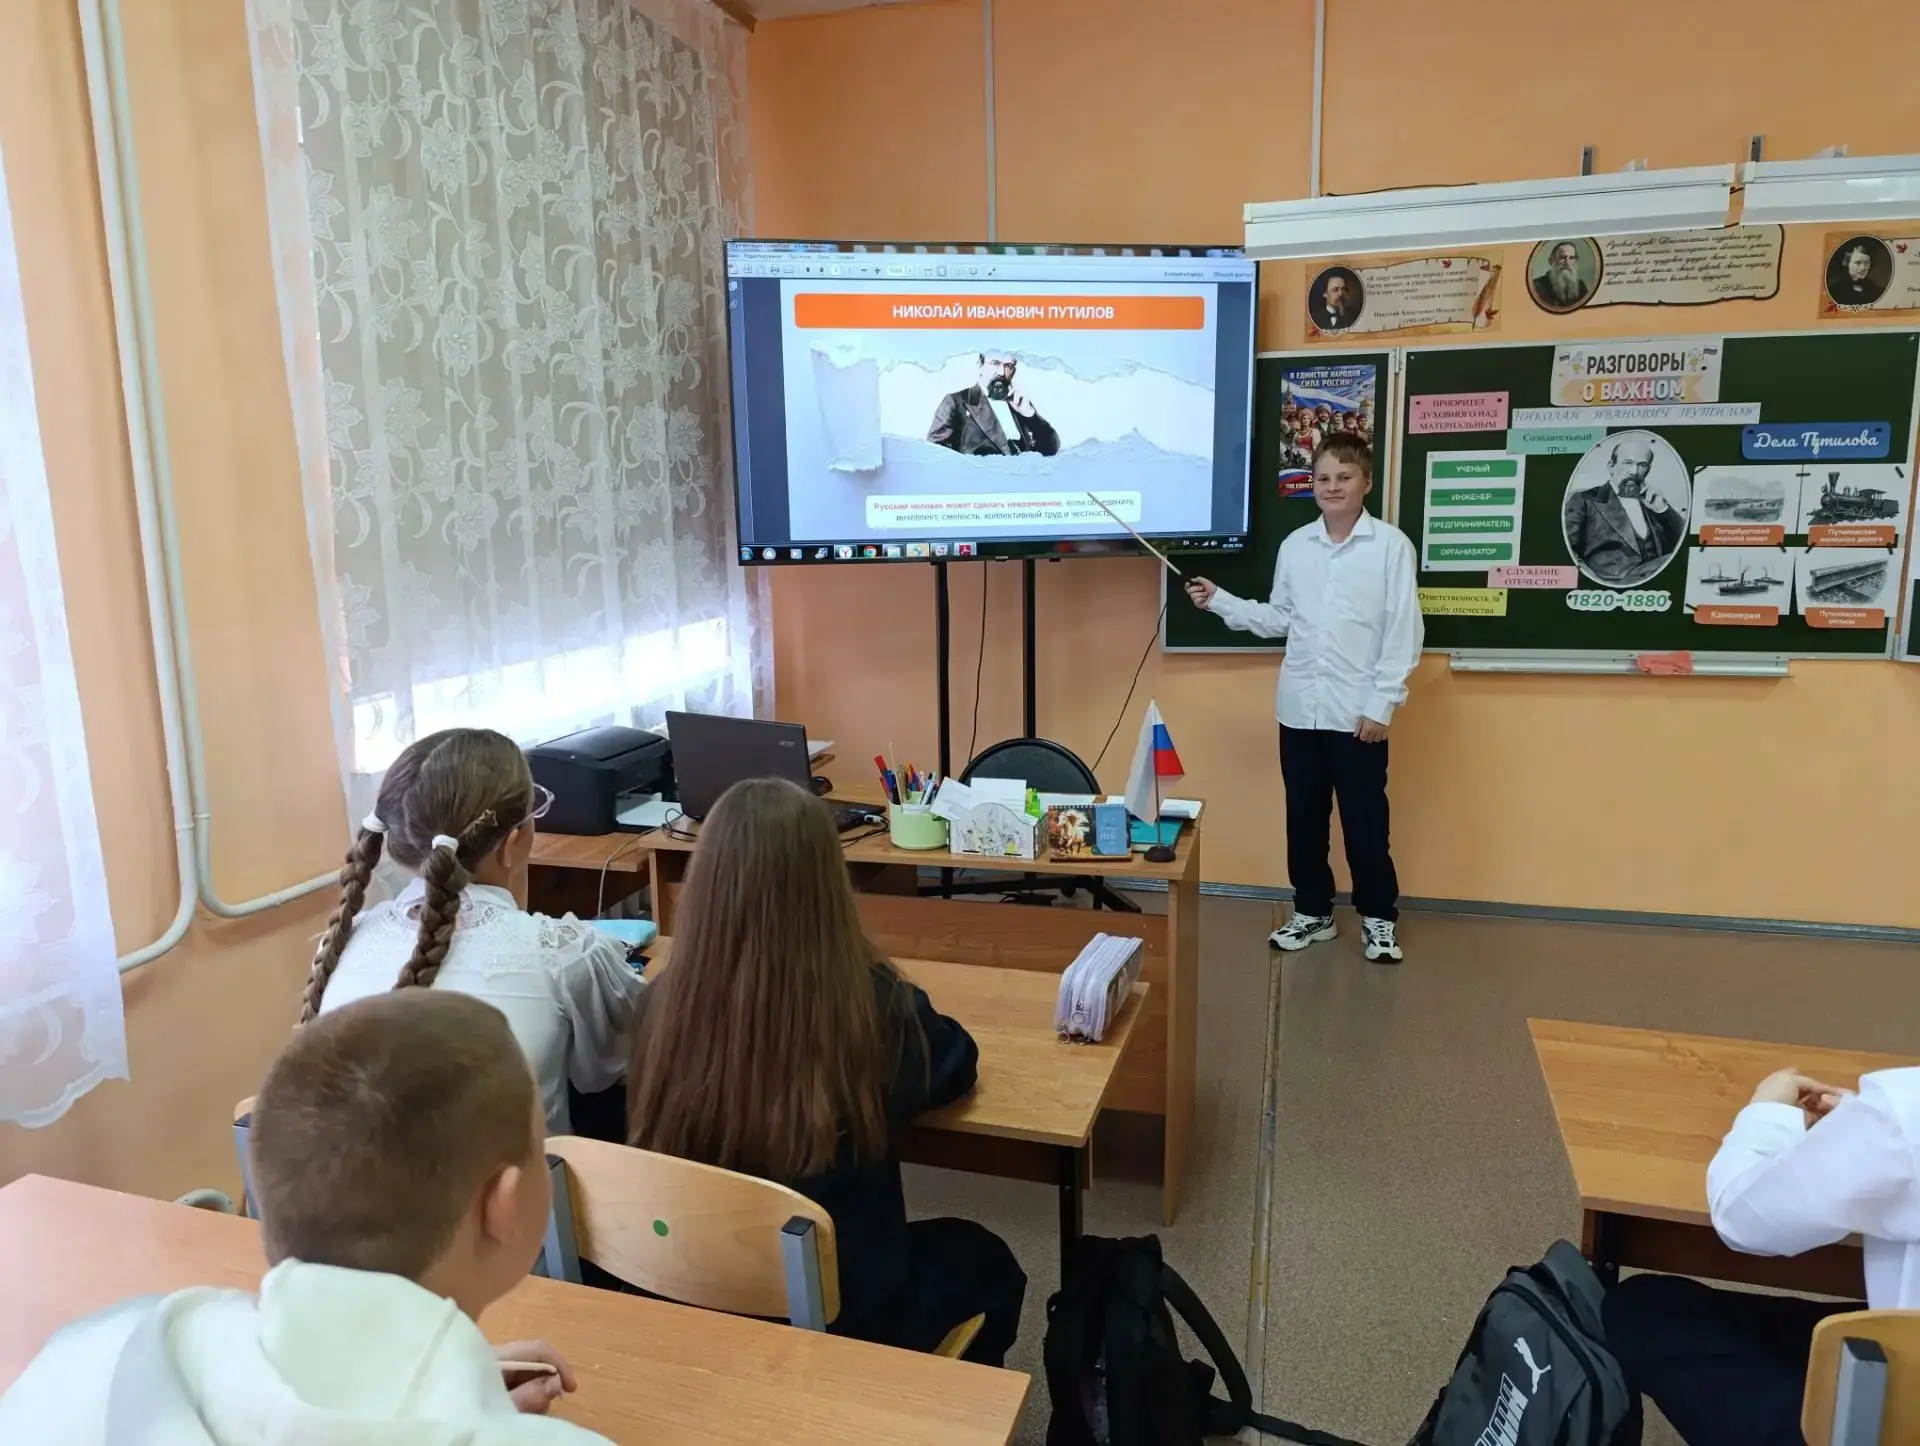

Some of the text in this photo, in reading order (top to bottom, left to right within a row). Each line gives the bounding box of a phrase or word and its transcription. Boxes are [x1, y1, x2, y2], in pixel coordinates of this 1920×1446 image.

[892, 303, 1115, 319] НИКОЛАЙ ИВАНОВИЧ ПУТИЛОВ
[1586, 351, 1686, 375] РАЗГОВОРЫ
[1296, 371, 1329, 379] ЕДИНСТВЕ
[1330, 370, 1361, 379] НАРОДОВ
[1300, 378, 1354, 388] СИЛА РОССИИ!
[1582, 379, 1686, 402] О ВАЖНОМ
[1432, 399, 1486, 408] ПРИОРИТЕТ
[1420, 409, 1498, 419] ДУХОВНОГО НАД
[1420, 421, 1497, 430] МАТЕРИАЛЬНЫМ
[1753, 429, 1879, 455] Дела Путилова
[1451, 493, 1492, 501] ИНЖЕНЕР
[1044, 511, 1062, 520] труд
[1429, 519, 1511, 529] ПРЕДПРИНИМАТЕЛЬ
[1440, 548, 1497, 556] ОРГАНИЗАТОР
[1506, 567, 1560, 576] СЛУЖЕНИЕ
[1504, 578, 1561, 586] ОТЕЧЕСТВУ
[1418, 592, 1489, 602] Ответственность
[1711, 610, 1761, 621] Канонерки
